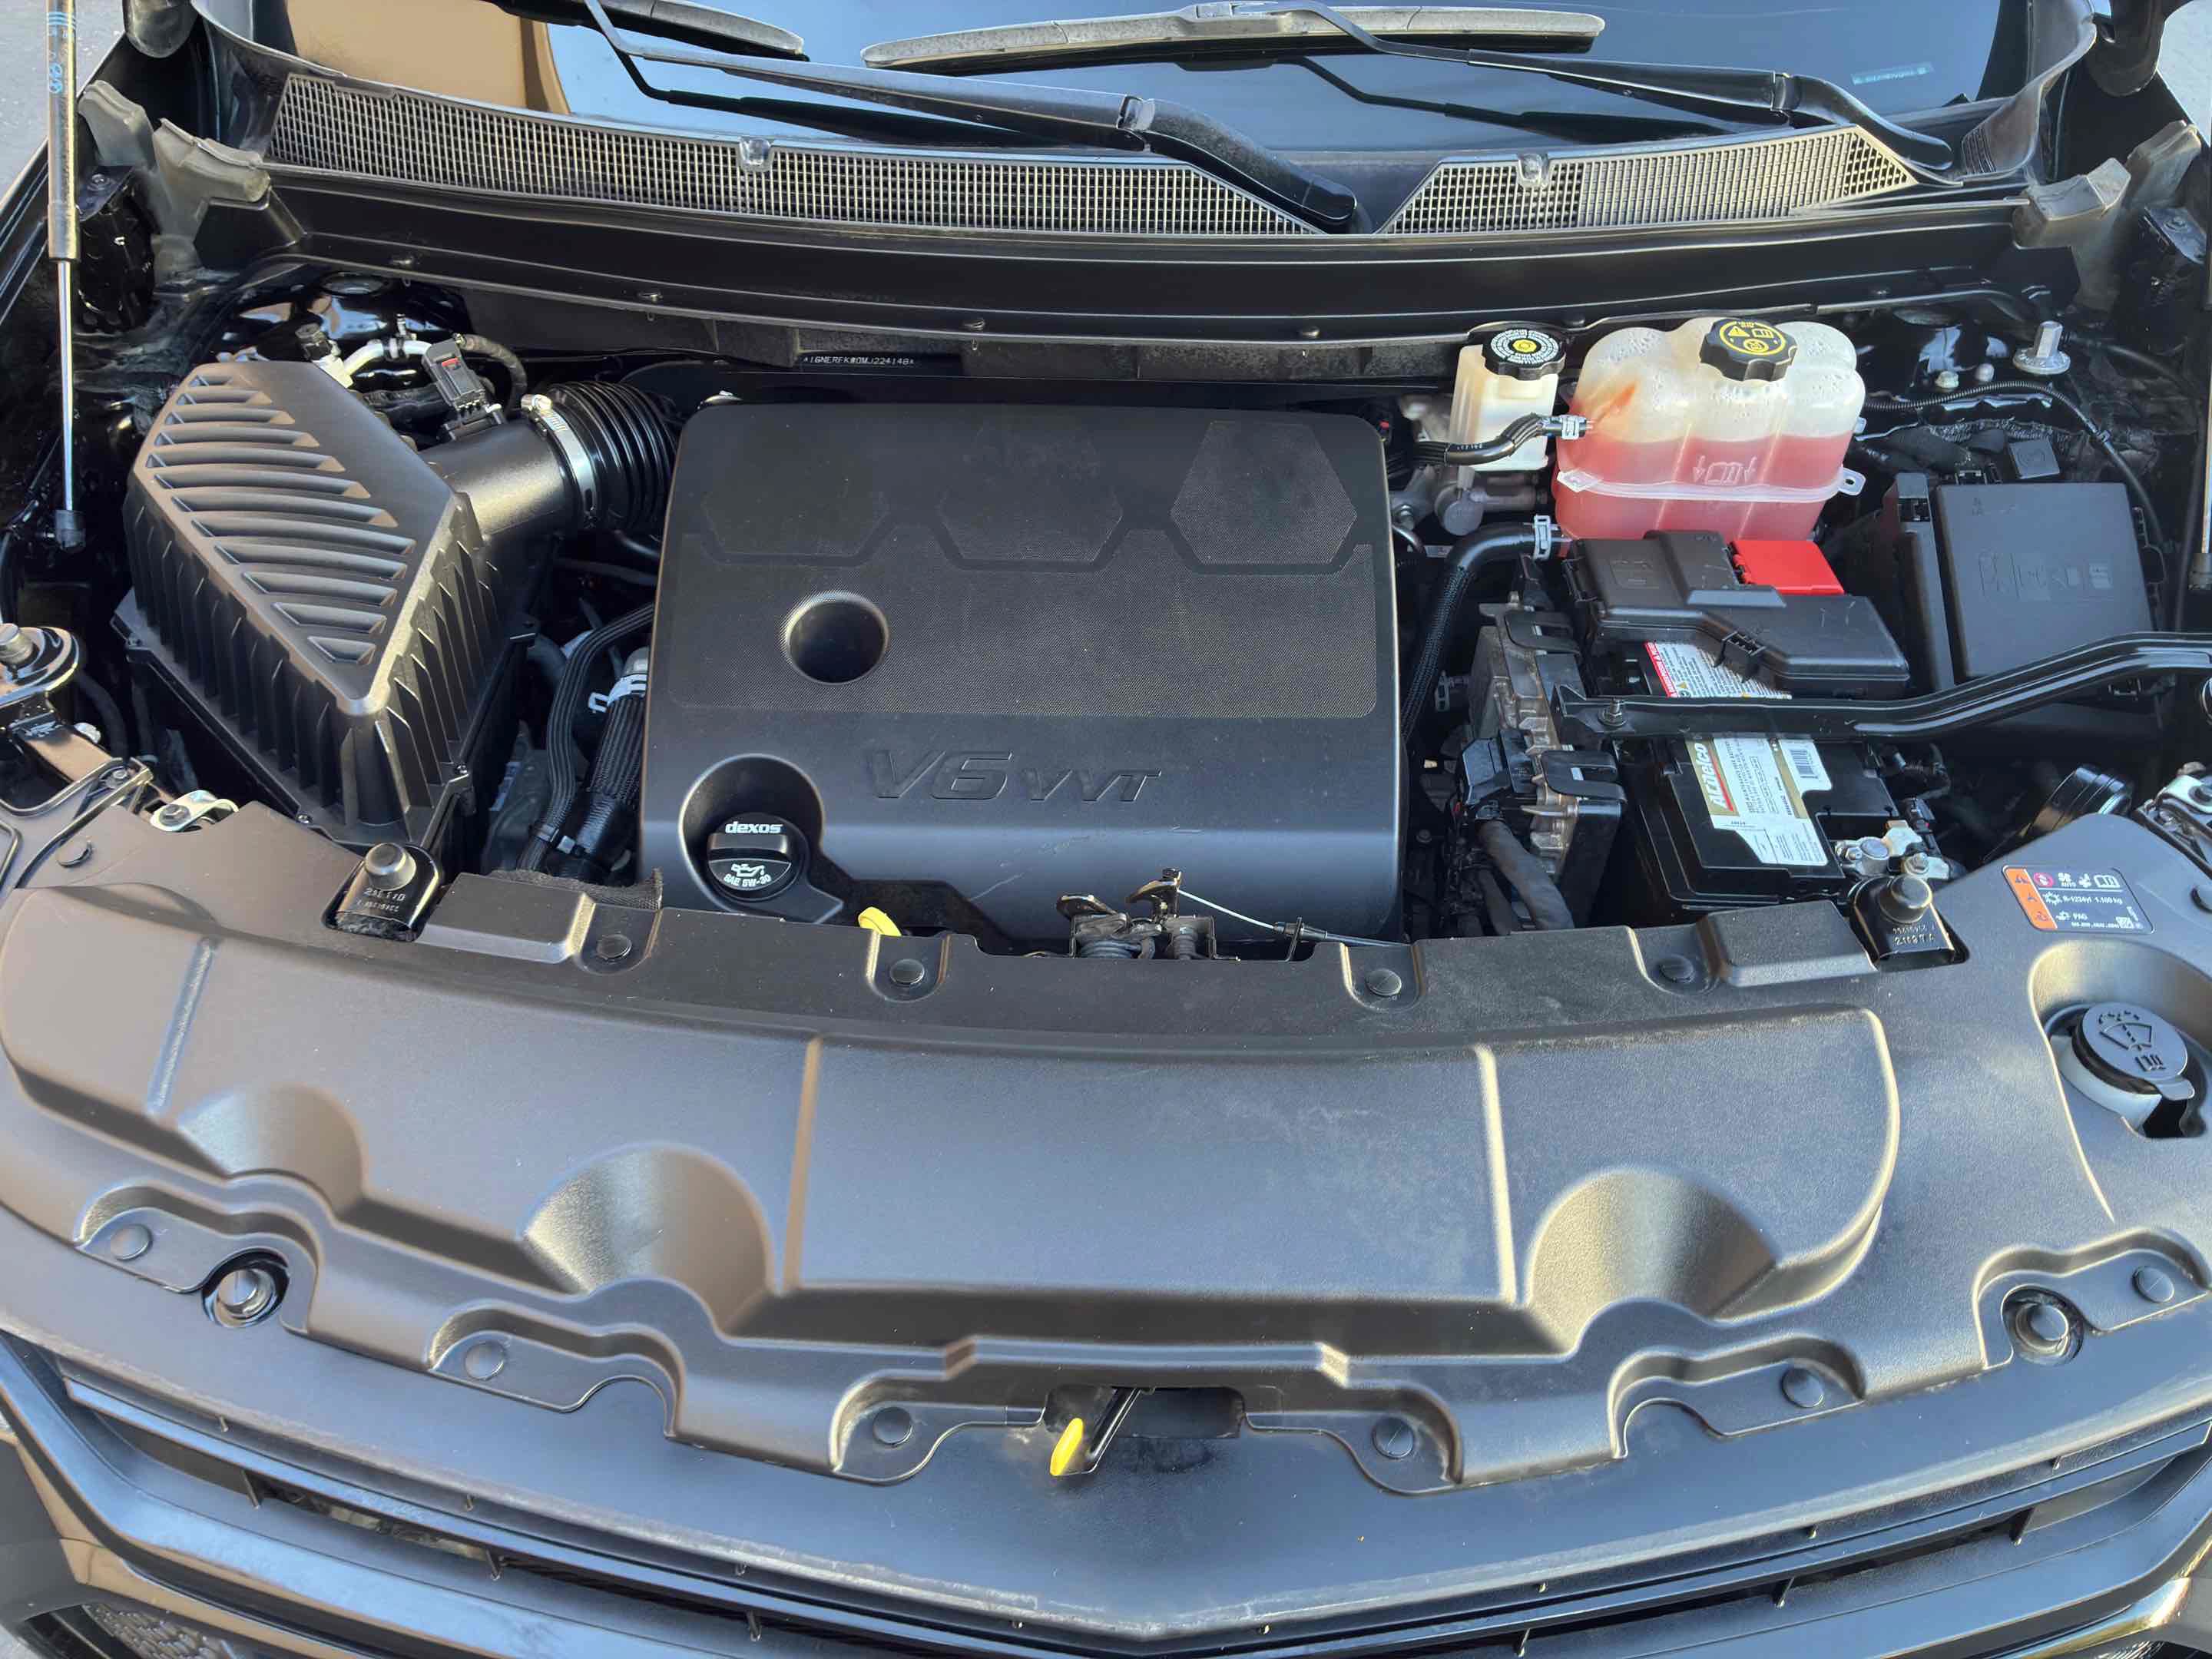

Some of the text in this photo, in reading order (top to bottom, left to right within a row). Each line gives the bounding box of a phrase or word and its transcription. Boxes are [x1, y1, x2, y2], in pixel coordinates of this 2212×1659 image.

[866, 749, 1161, 802] V6 VVT
[1694, 742, 1730, 810] ACDelco
[725, 821, 783, 833] dexos
[724, 873, 772, 887] SAE 5W-30
